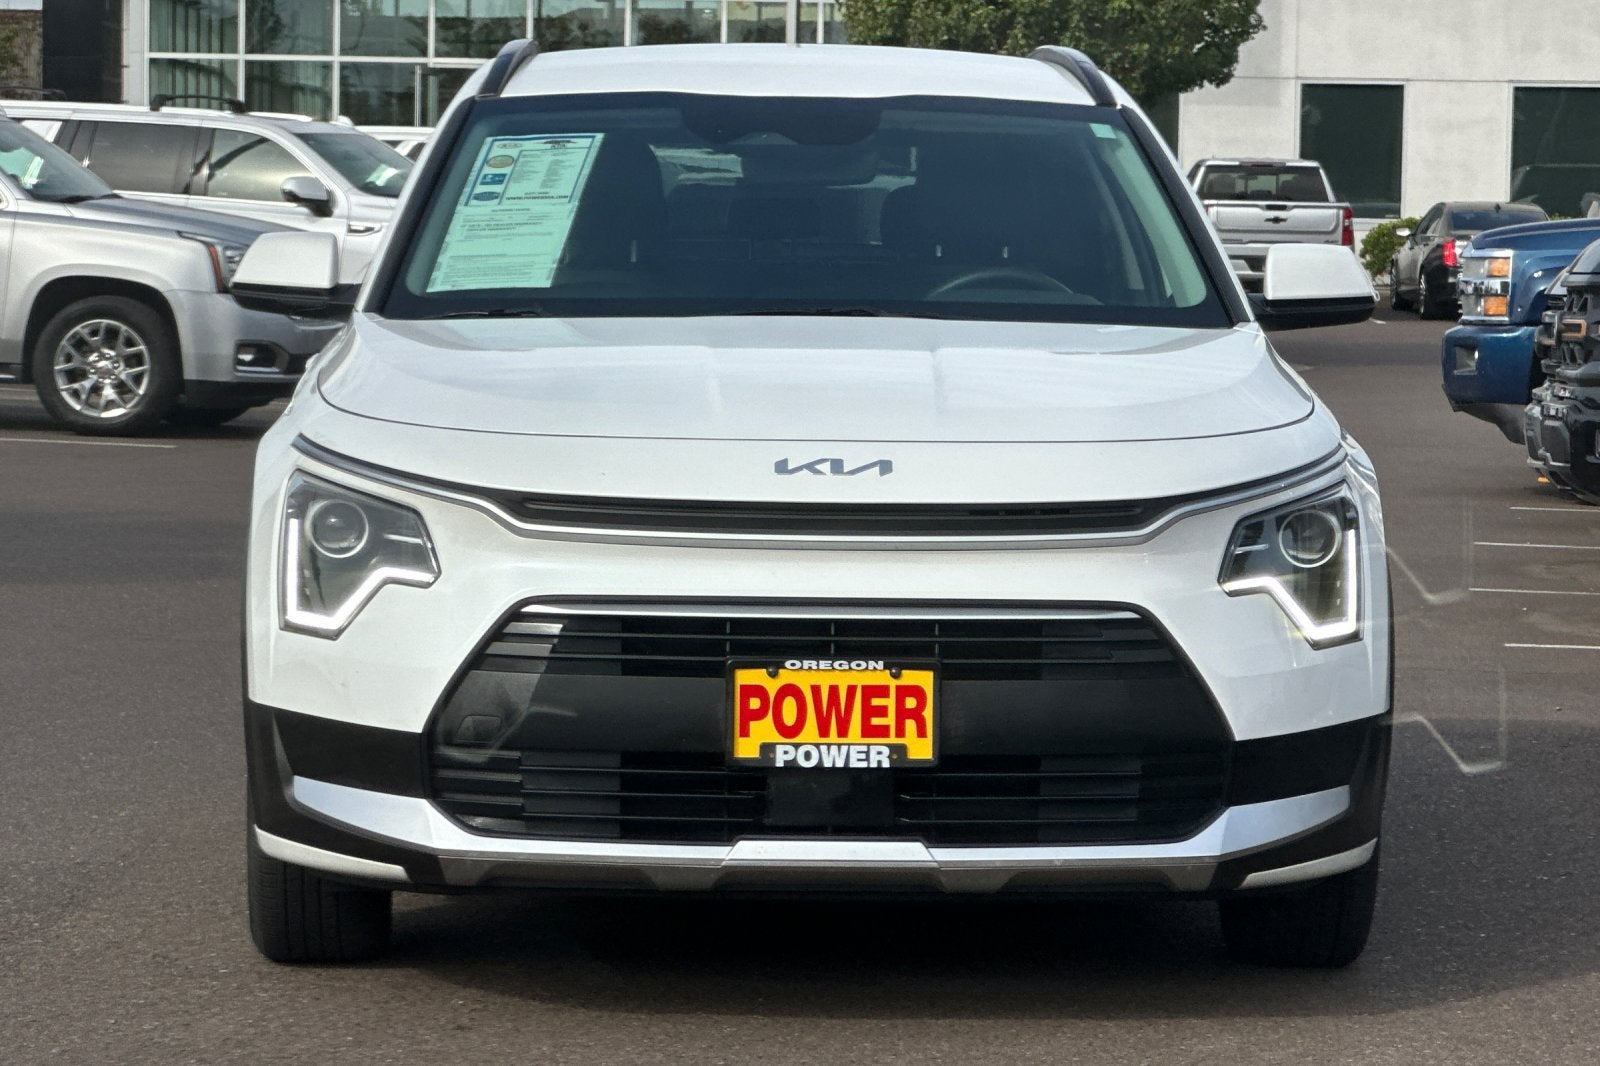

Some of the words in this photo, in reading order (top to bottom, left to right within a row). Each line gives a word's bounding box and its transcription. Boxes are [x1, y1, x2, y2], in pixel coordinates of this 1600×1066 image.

[774, 457, 893, 477] KIA
[784, 659, 884, 671] OREGON
[738, 683, 927, 739] POWER
[775, 744, 890, 768] POWER
